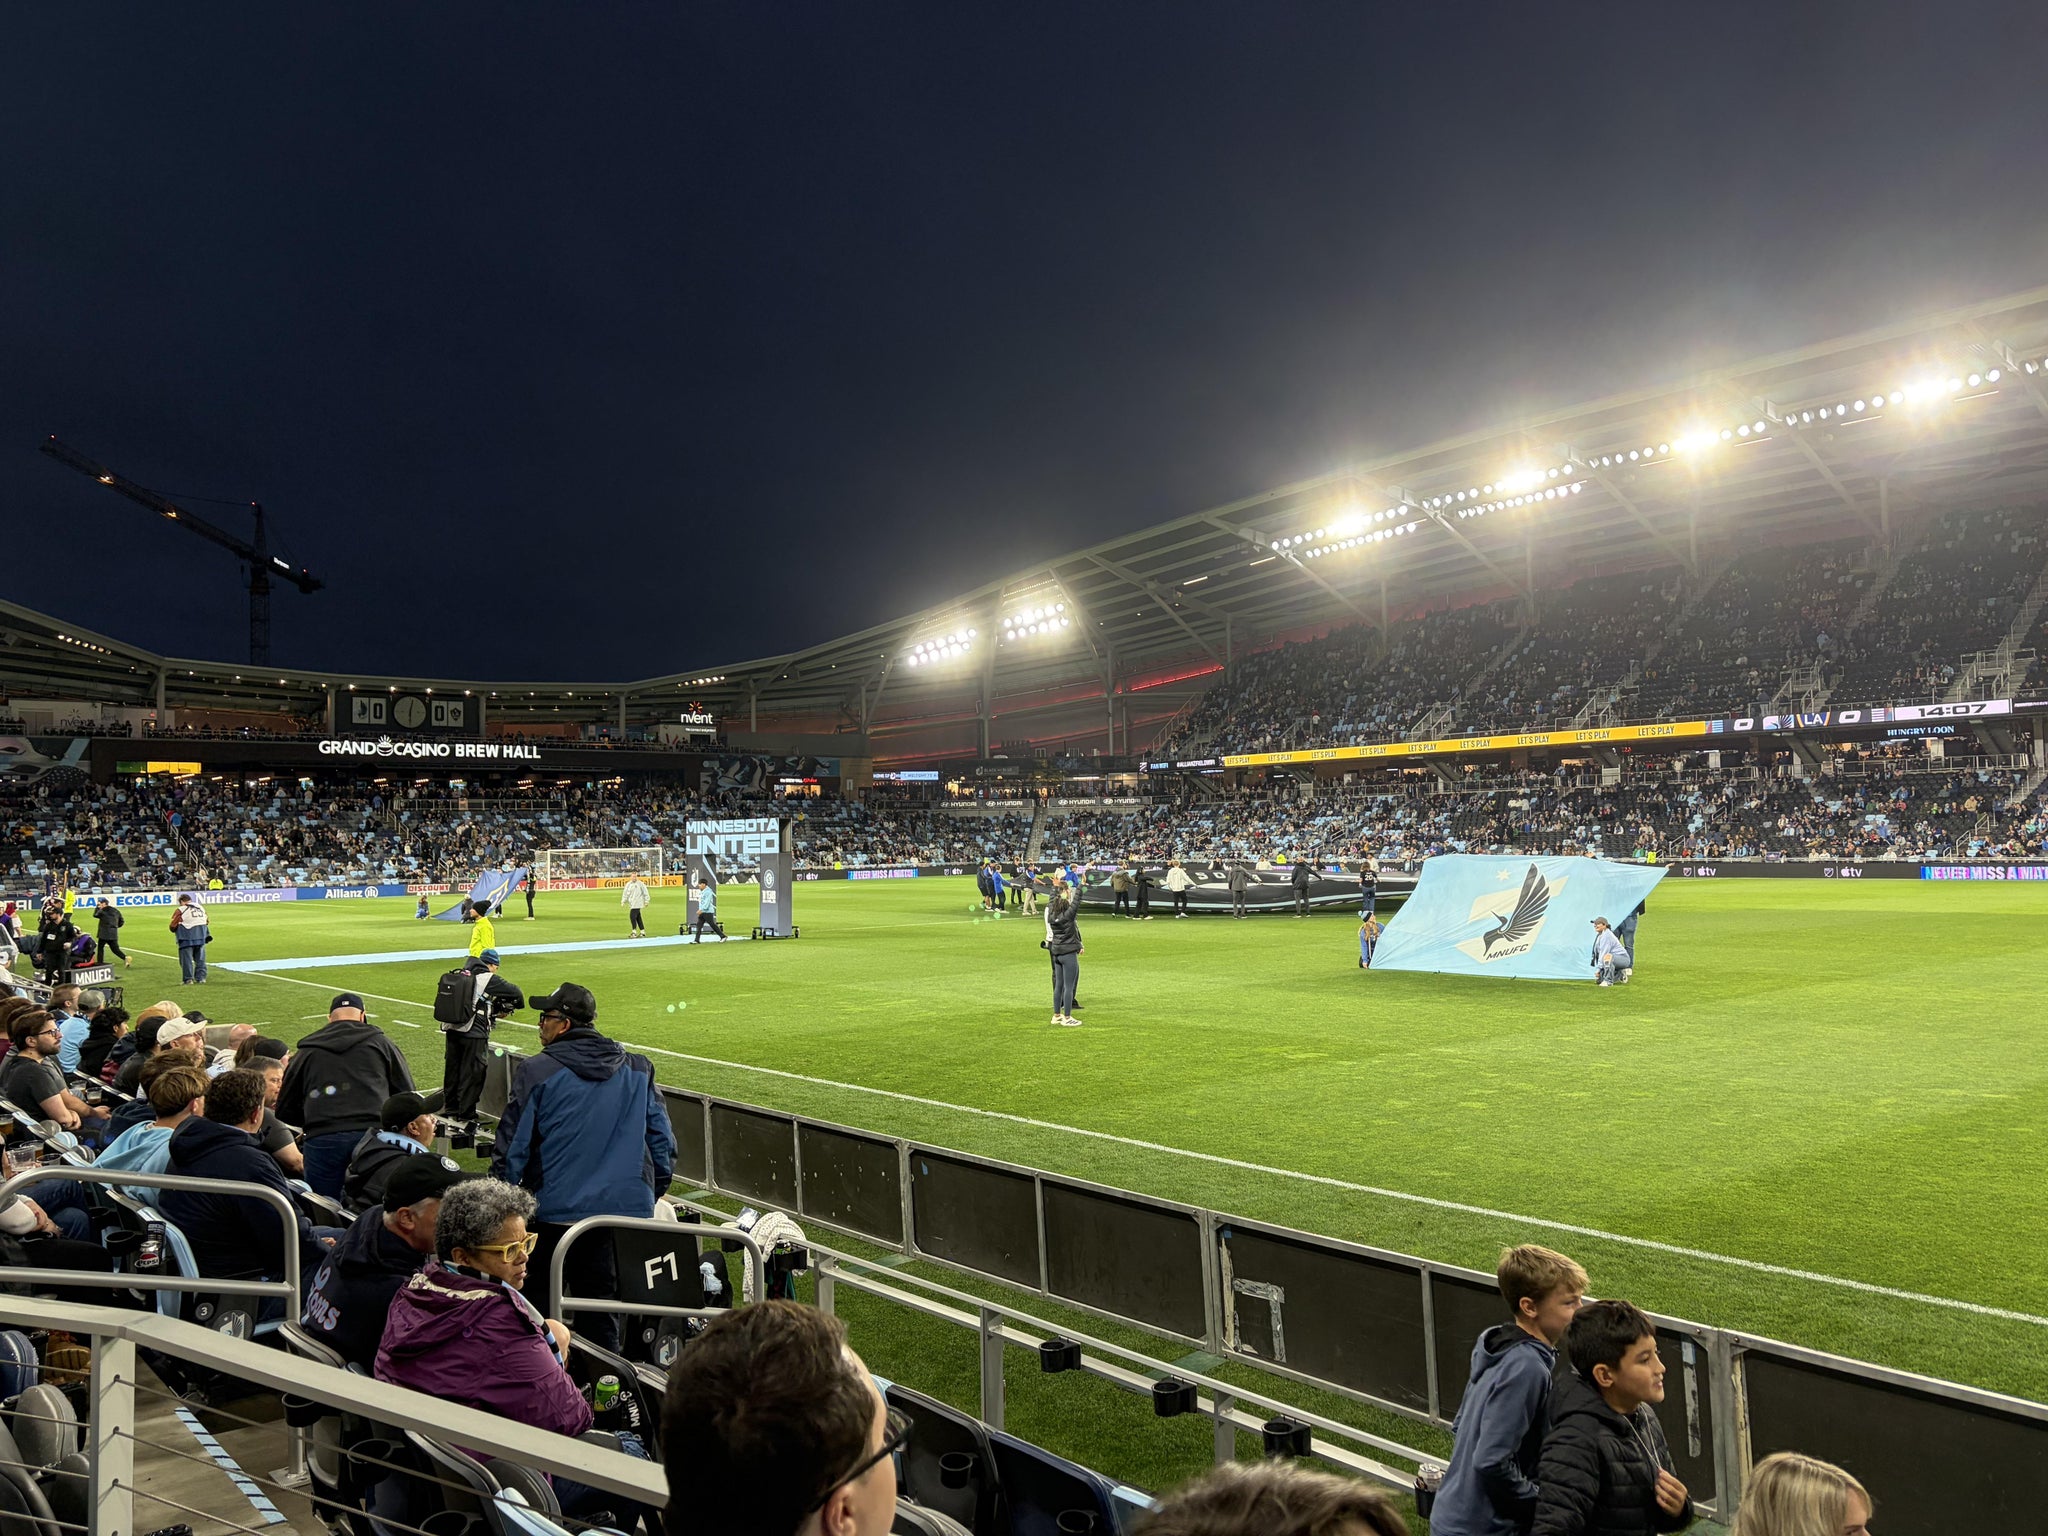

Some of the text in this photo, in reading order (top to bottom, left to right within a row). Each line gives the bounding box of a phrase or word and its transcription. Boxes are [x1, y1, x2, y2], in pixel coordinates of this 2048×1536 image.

[1918, 704, 1987, 717] 14:07
[1804, 714, 1823, 726] LA
[1839, 711, 1861, 724] 0
[1733, 718, 1754, 731] 0
[1576, 730, 1610, 740] LET'S PLAY
[1638, 726, 1674, 736] LET'S PLAY
[1887, 726, 1954, 736] HUNGRY LOON
[1476, 739, 1490, 747] PLAY
[1517, 735, 1550, 744] LET'S PLAY
[319, 740, 541, 759] GRAND CASINO BREW HALL
[1424, 743, 1437, 751] PLAY
[686, 818, 779, 834] MINNESOTA
[686, 834, 779, 854] UNITED
[1924, 866, 1969, 880] NEVER
[1970, 866, 2005, 880] MISS
[2007, 866, 2018, 880] A
[325, 888, 363, 899] Allianz
[408, 884, 450, 892] DISCOUNT
[116, 894, 172, 906] ECOLAB
[195, 891, 280, 905] NutriSource
[1486, 944, 1529, 960] MNUFC
[75, 968, 111, 985] MNUFC
[644, 1252, 678, 1290] F1
[201, 1307, 208, 1316] 3
